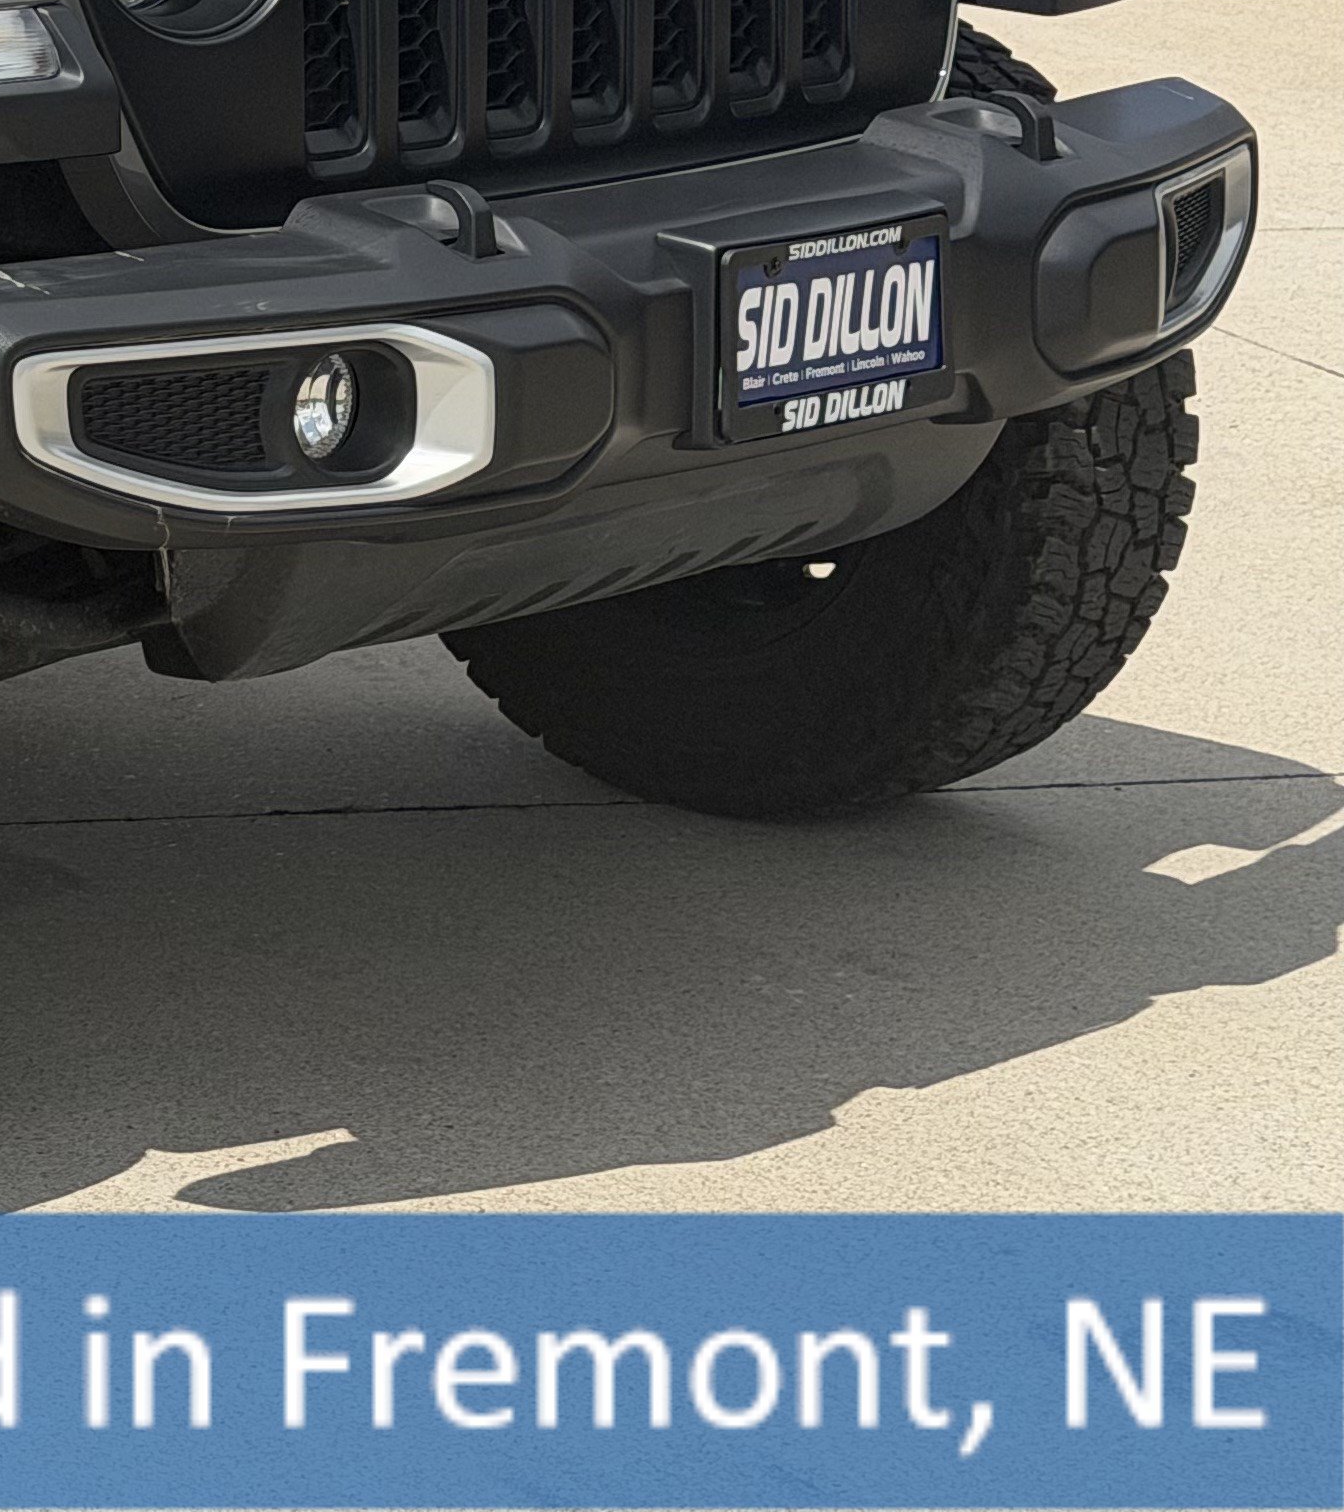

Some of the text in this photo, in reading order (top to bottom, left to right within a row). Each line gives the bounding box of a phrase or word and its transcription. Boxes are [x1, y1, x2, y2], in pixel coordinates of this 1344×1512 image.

[788, 225, 903, 262] SIDDILLON.COM
[736, 259, 936, 372] SID DILLON
[742, 374, 766, 391] Blair
[772, 372, 800, 386] Crete
[852, 355, 885, 372] Lincoln
[891, 349, 926, 365] Wahoo
[782, 378, 907, 433] SID DILLON
